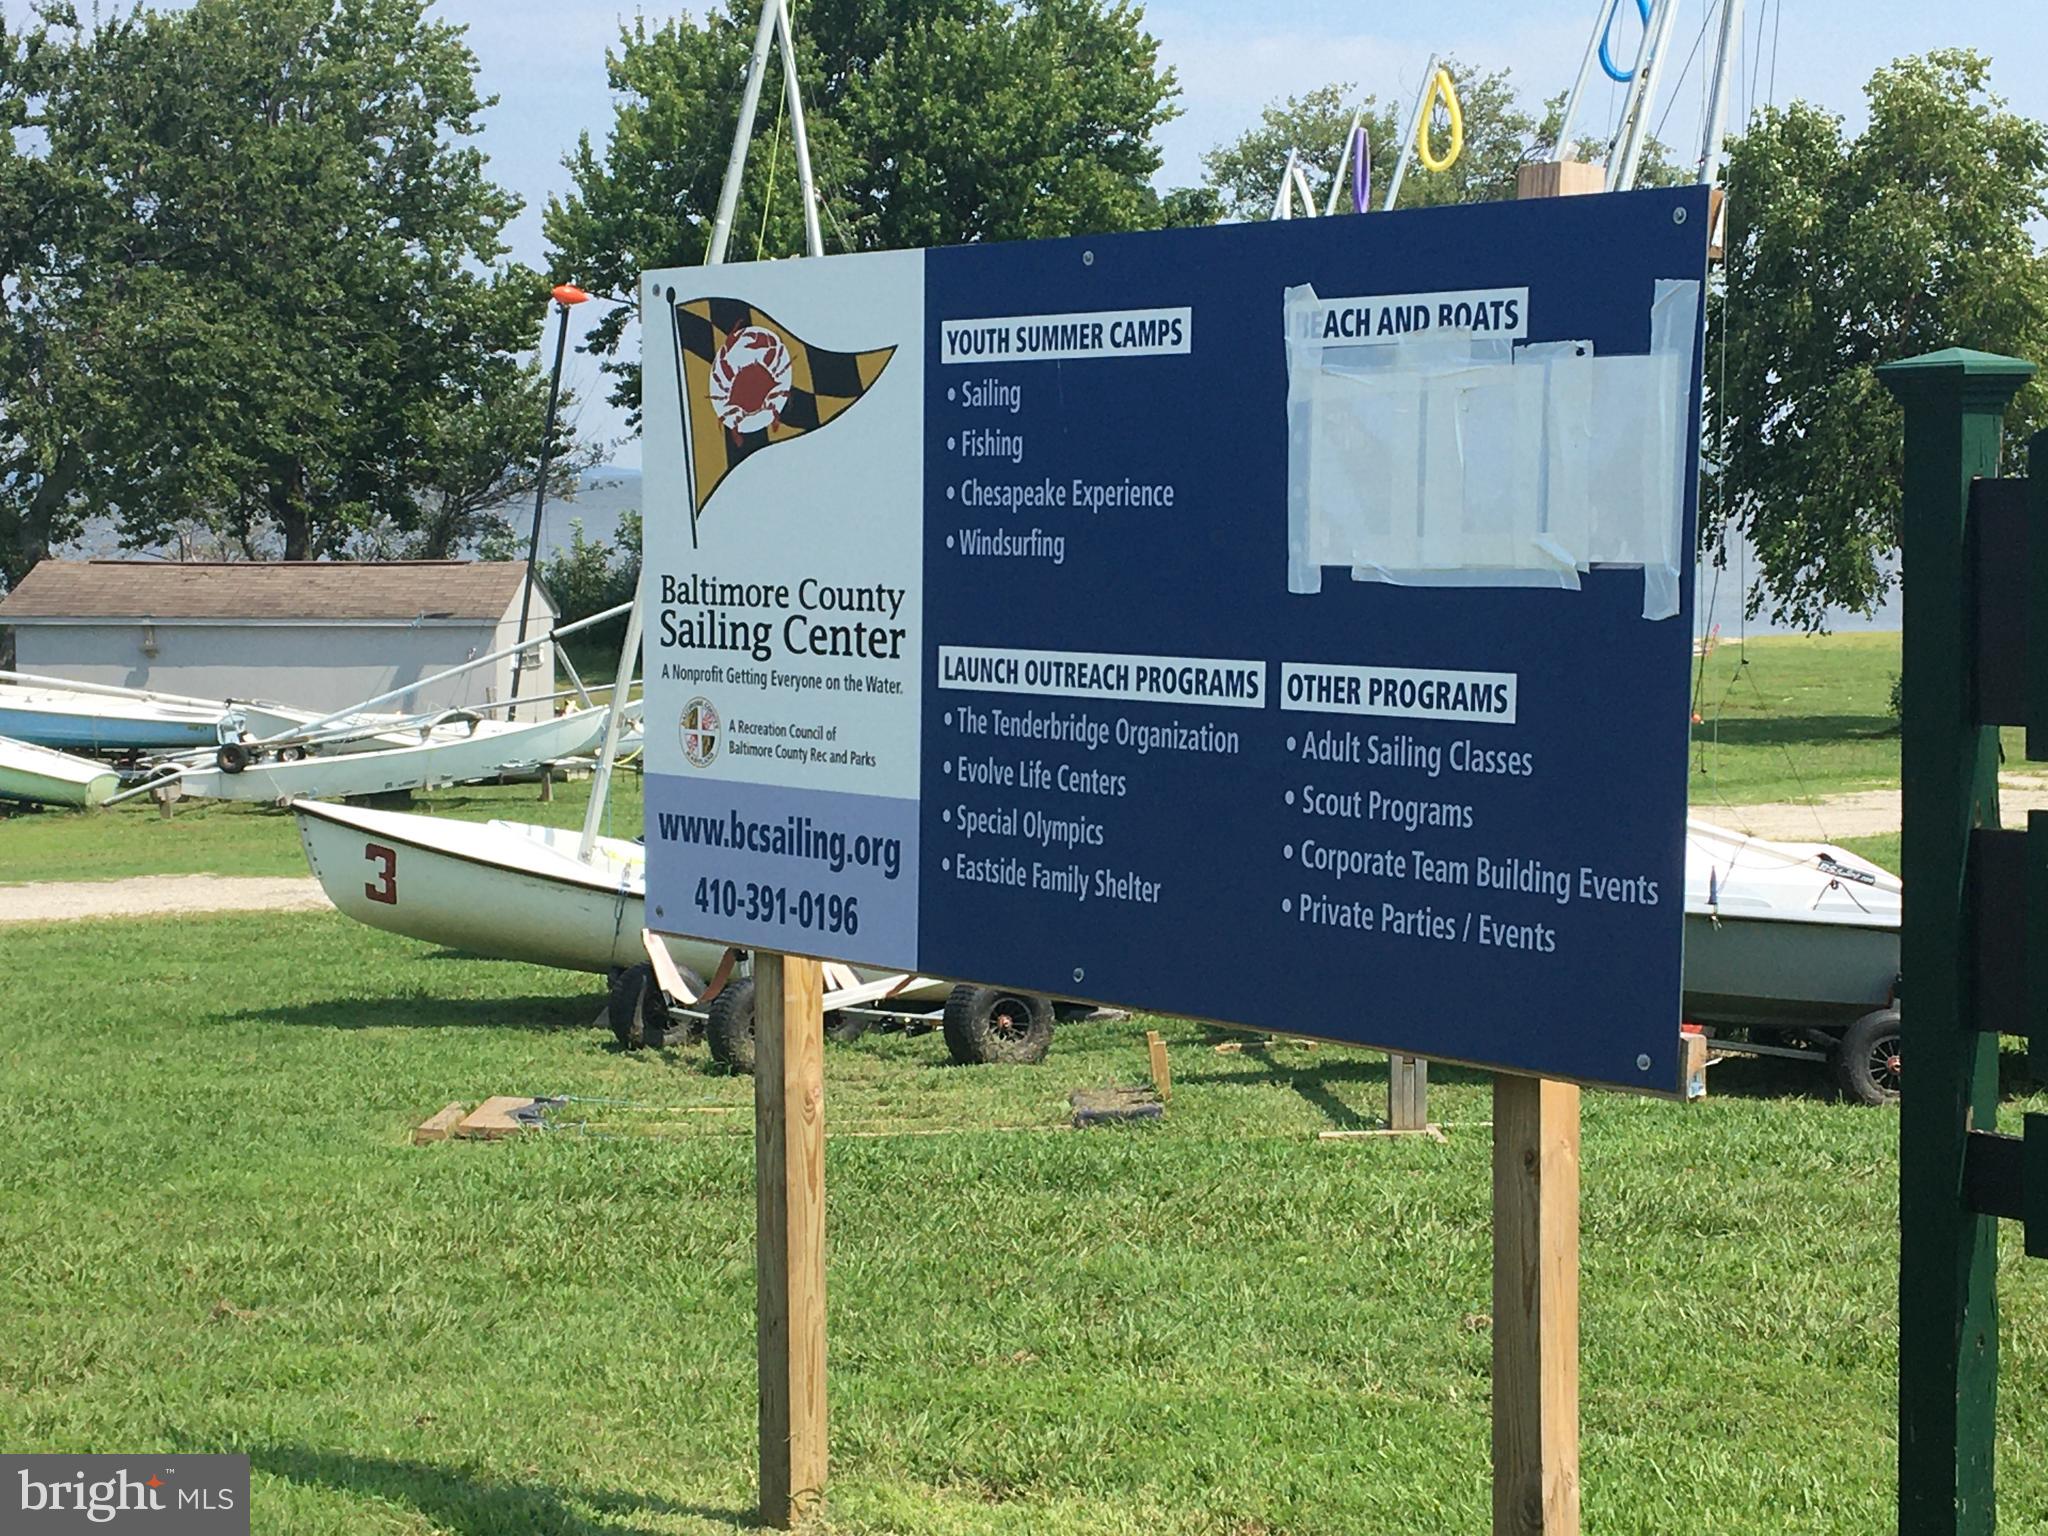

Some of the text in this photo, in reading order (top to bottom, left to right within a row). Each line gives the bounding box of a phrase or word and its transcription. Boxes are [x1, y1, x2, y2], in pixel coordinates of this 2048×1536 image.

[947, 318, 1183, 356] YOUTH SUMMER CAMPS
[1377, 305, 1431, 336] AND
[1438, 299, 1519, 331] BOATS
[961, 378, 1021, 413] Sailing
[961, 428, 1023, 463] Fishing
[961, 478, 1174, 514] Chesapeake Experience
[959, 528, 1065, 564] Windsurfing
[661, 574, 906, 620] Baltimore County
[660, 609, 906, 662] Sailing Center
[662, 664, 903, 694] A Nonprofit Getting Everyone on the Water.
[944, 656, 1259, 699] LAUNCH OUTREACH PROGRAMS
[1287, 673, 1508, 714] OTHER PROGRAMS
[728, 720, 838, 741] A Recreation Council of
[957, 707, 1239, 755] The Tenderbridge Organization
[729, 741, 773, 758] Baltimore
[775, 744, 808, 765] County
[810, 748, 827, 763] Rec
[829, 751, 848, 765] and
[850, 752, 876, 768] Parks
[1302, 730, 1534, 777] Adult Sailing Classes
[958, 756, 1126, 797] Evolve Life Centers
[957, 804, 1104, 850] Special Olympics
[1303, 785, 1474, 832] Scout Programs
[658, 810, 901, 880] www.bcsailing.org
[365, 843, 397, 905] 3
[956, 853, 1161, 904] Eastside Family Shelter
[1301, 840, 1660, 906] Corporate Team Building Events
[694, 877, 859, 936] 410-391-0196
[1299, 893, 1556, 953] Private Parties / Events
